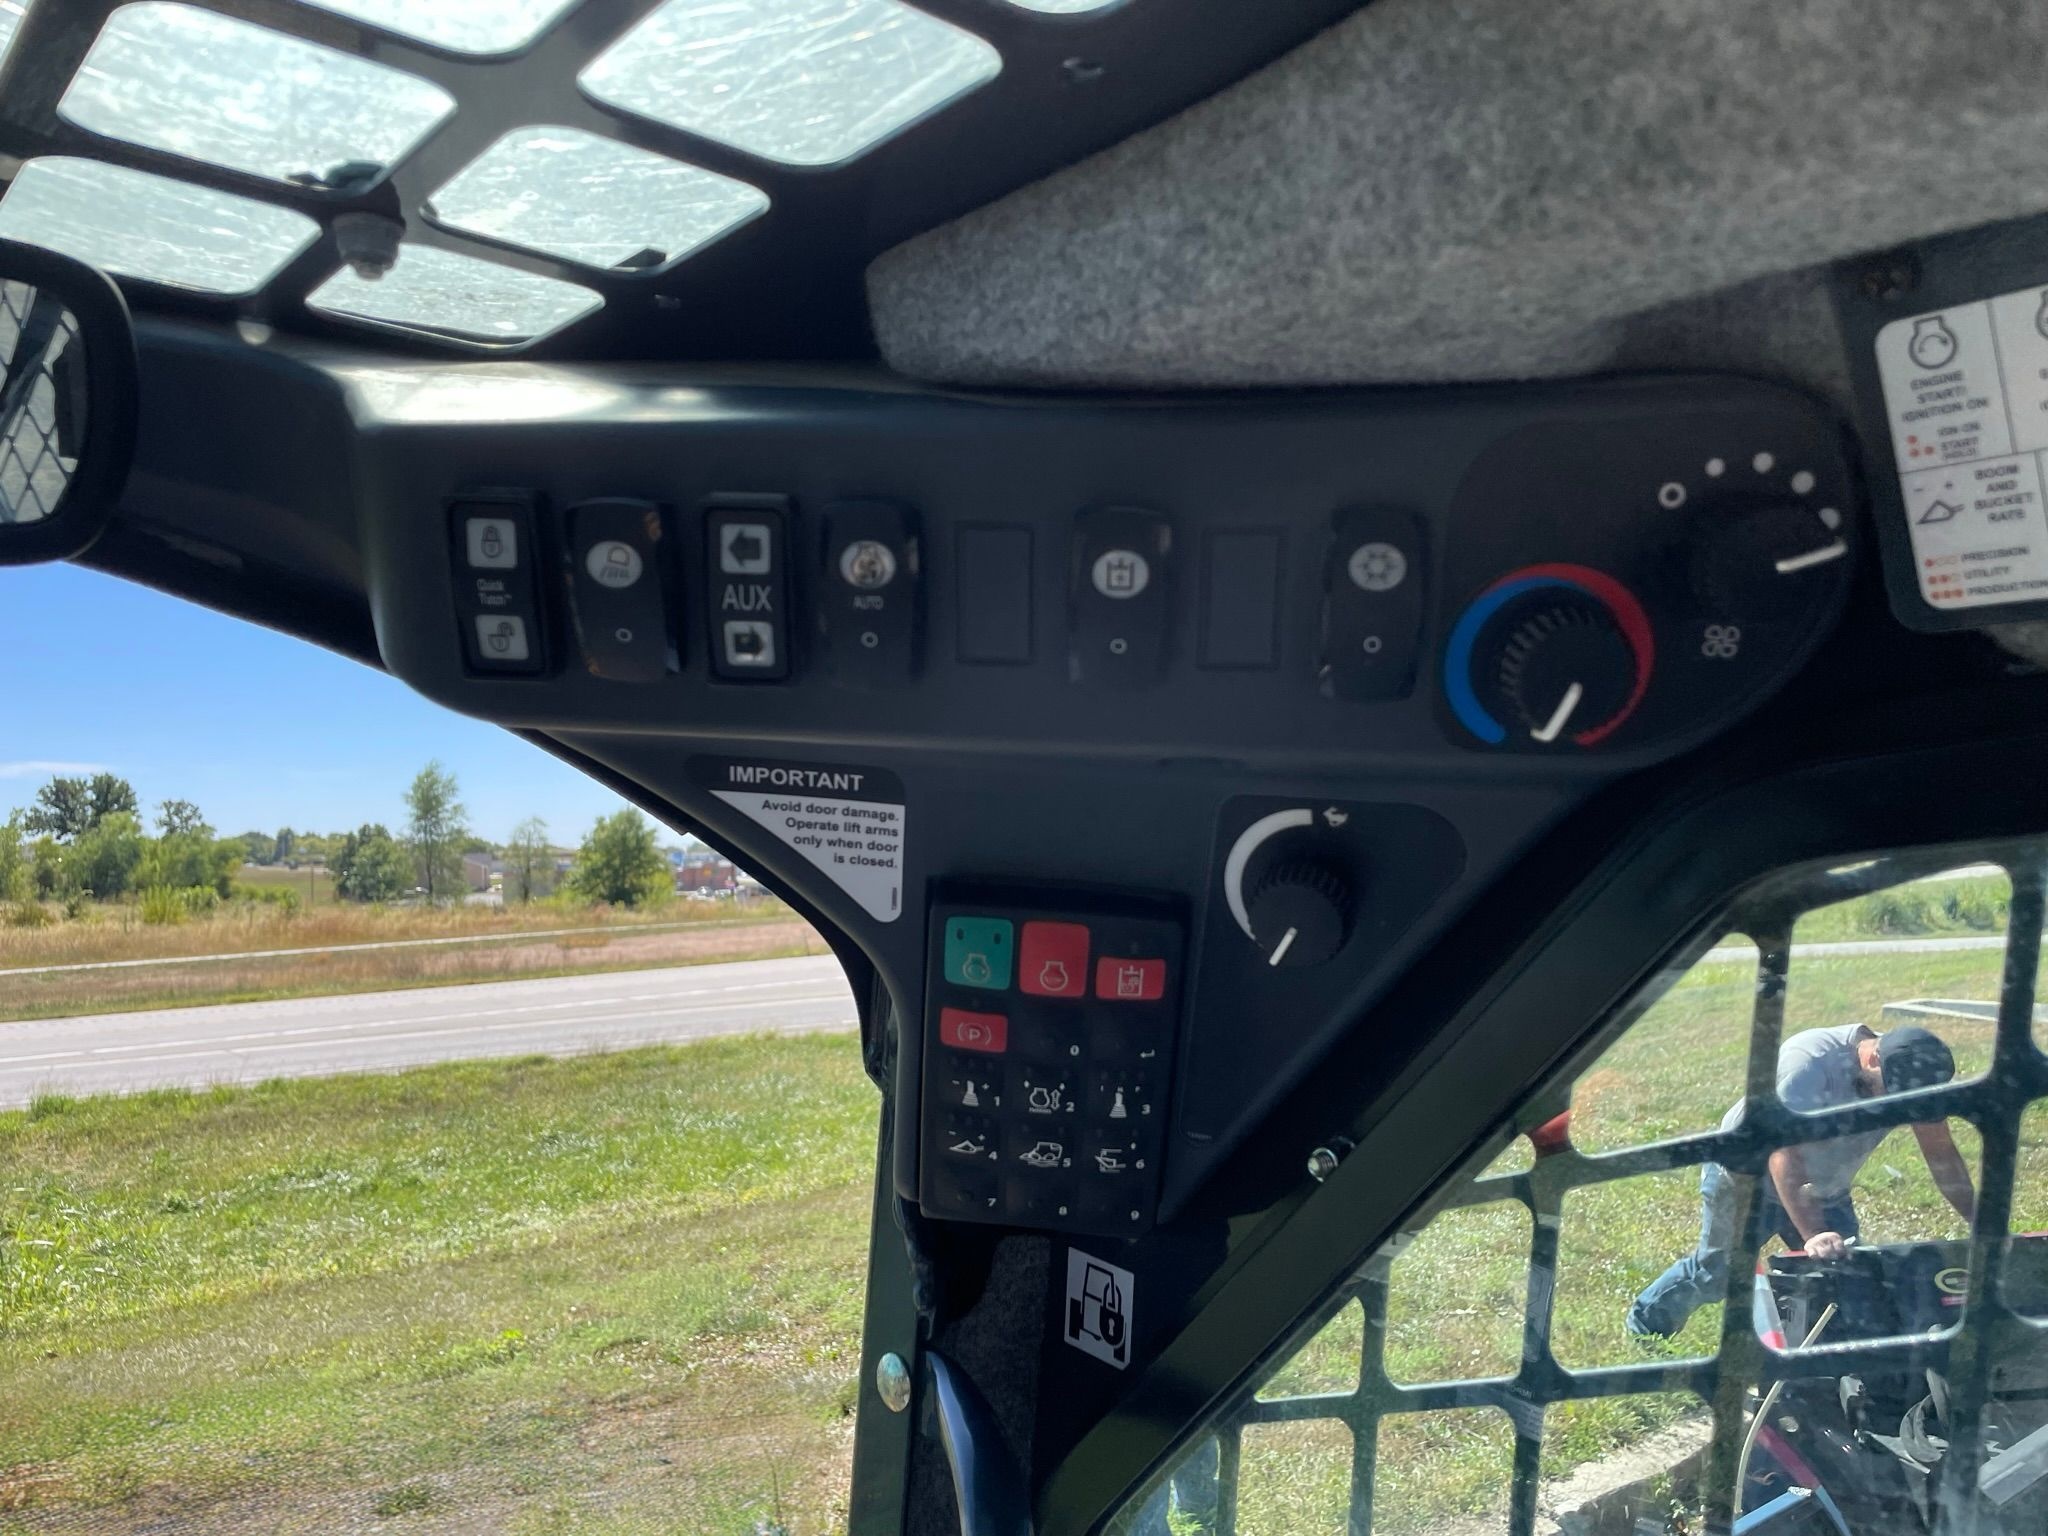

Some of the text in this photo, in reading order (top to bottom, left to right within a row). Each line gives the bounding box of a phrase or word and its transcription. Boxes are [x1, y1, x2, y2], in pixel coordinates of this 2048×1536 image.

[1910, 370, 1963, 390] ENGINE
[1901, 397, 1989, 422] IGNITION ON
[1975, 465, 2019, 481] BOOM
[1985, 479, 2018, 493] AND
[1974, 492, 2035, 510] BUCKET
[1987, 508, 2026, 522] RATE
[1961, 546, 2029, 562] PRECISION
[1964, 566, 2011, 579] UTILITY
[722, 583, 772, 611] AUX
[852, 595, 884, 610] AUTO
[729, 765, 864, 791] IMPORTANT
[761, 799, 899, 823] Avoid door damage.
[785, 817, 899, 838] Operate lift arms
[793, 834, 899, 853] only when door
[833, 852, 898, 869] is closed.
[994, 1096, 1000, 1106] 1
[1066, 1102, 1075, 1112] 2
[1142, 1104, 1150, 1114] 3
[989, 1151, 997, 1160] 4
[1063, 1158, 1071, 1167] 5
[1136, 1159, 1144, 1169] 6
[989, 1198, 997, 1207] 7
[1060, 1206, 1067, 1215] 8
[1131, 1210, 1139, 1220] 9
